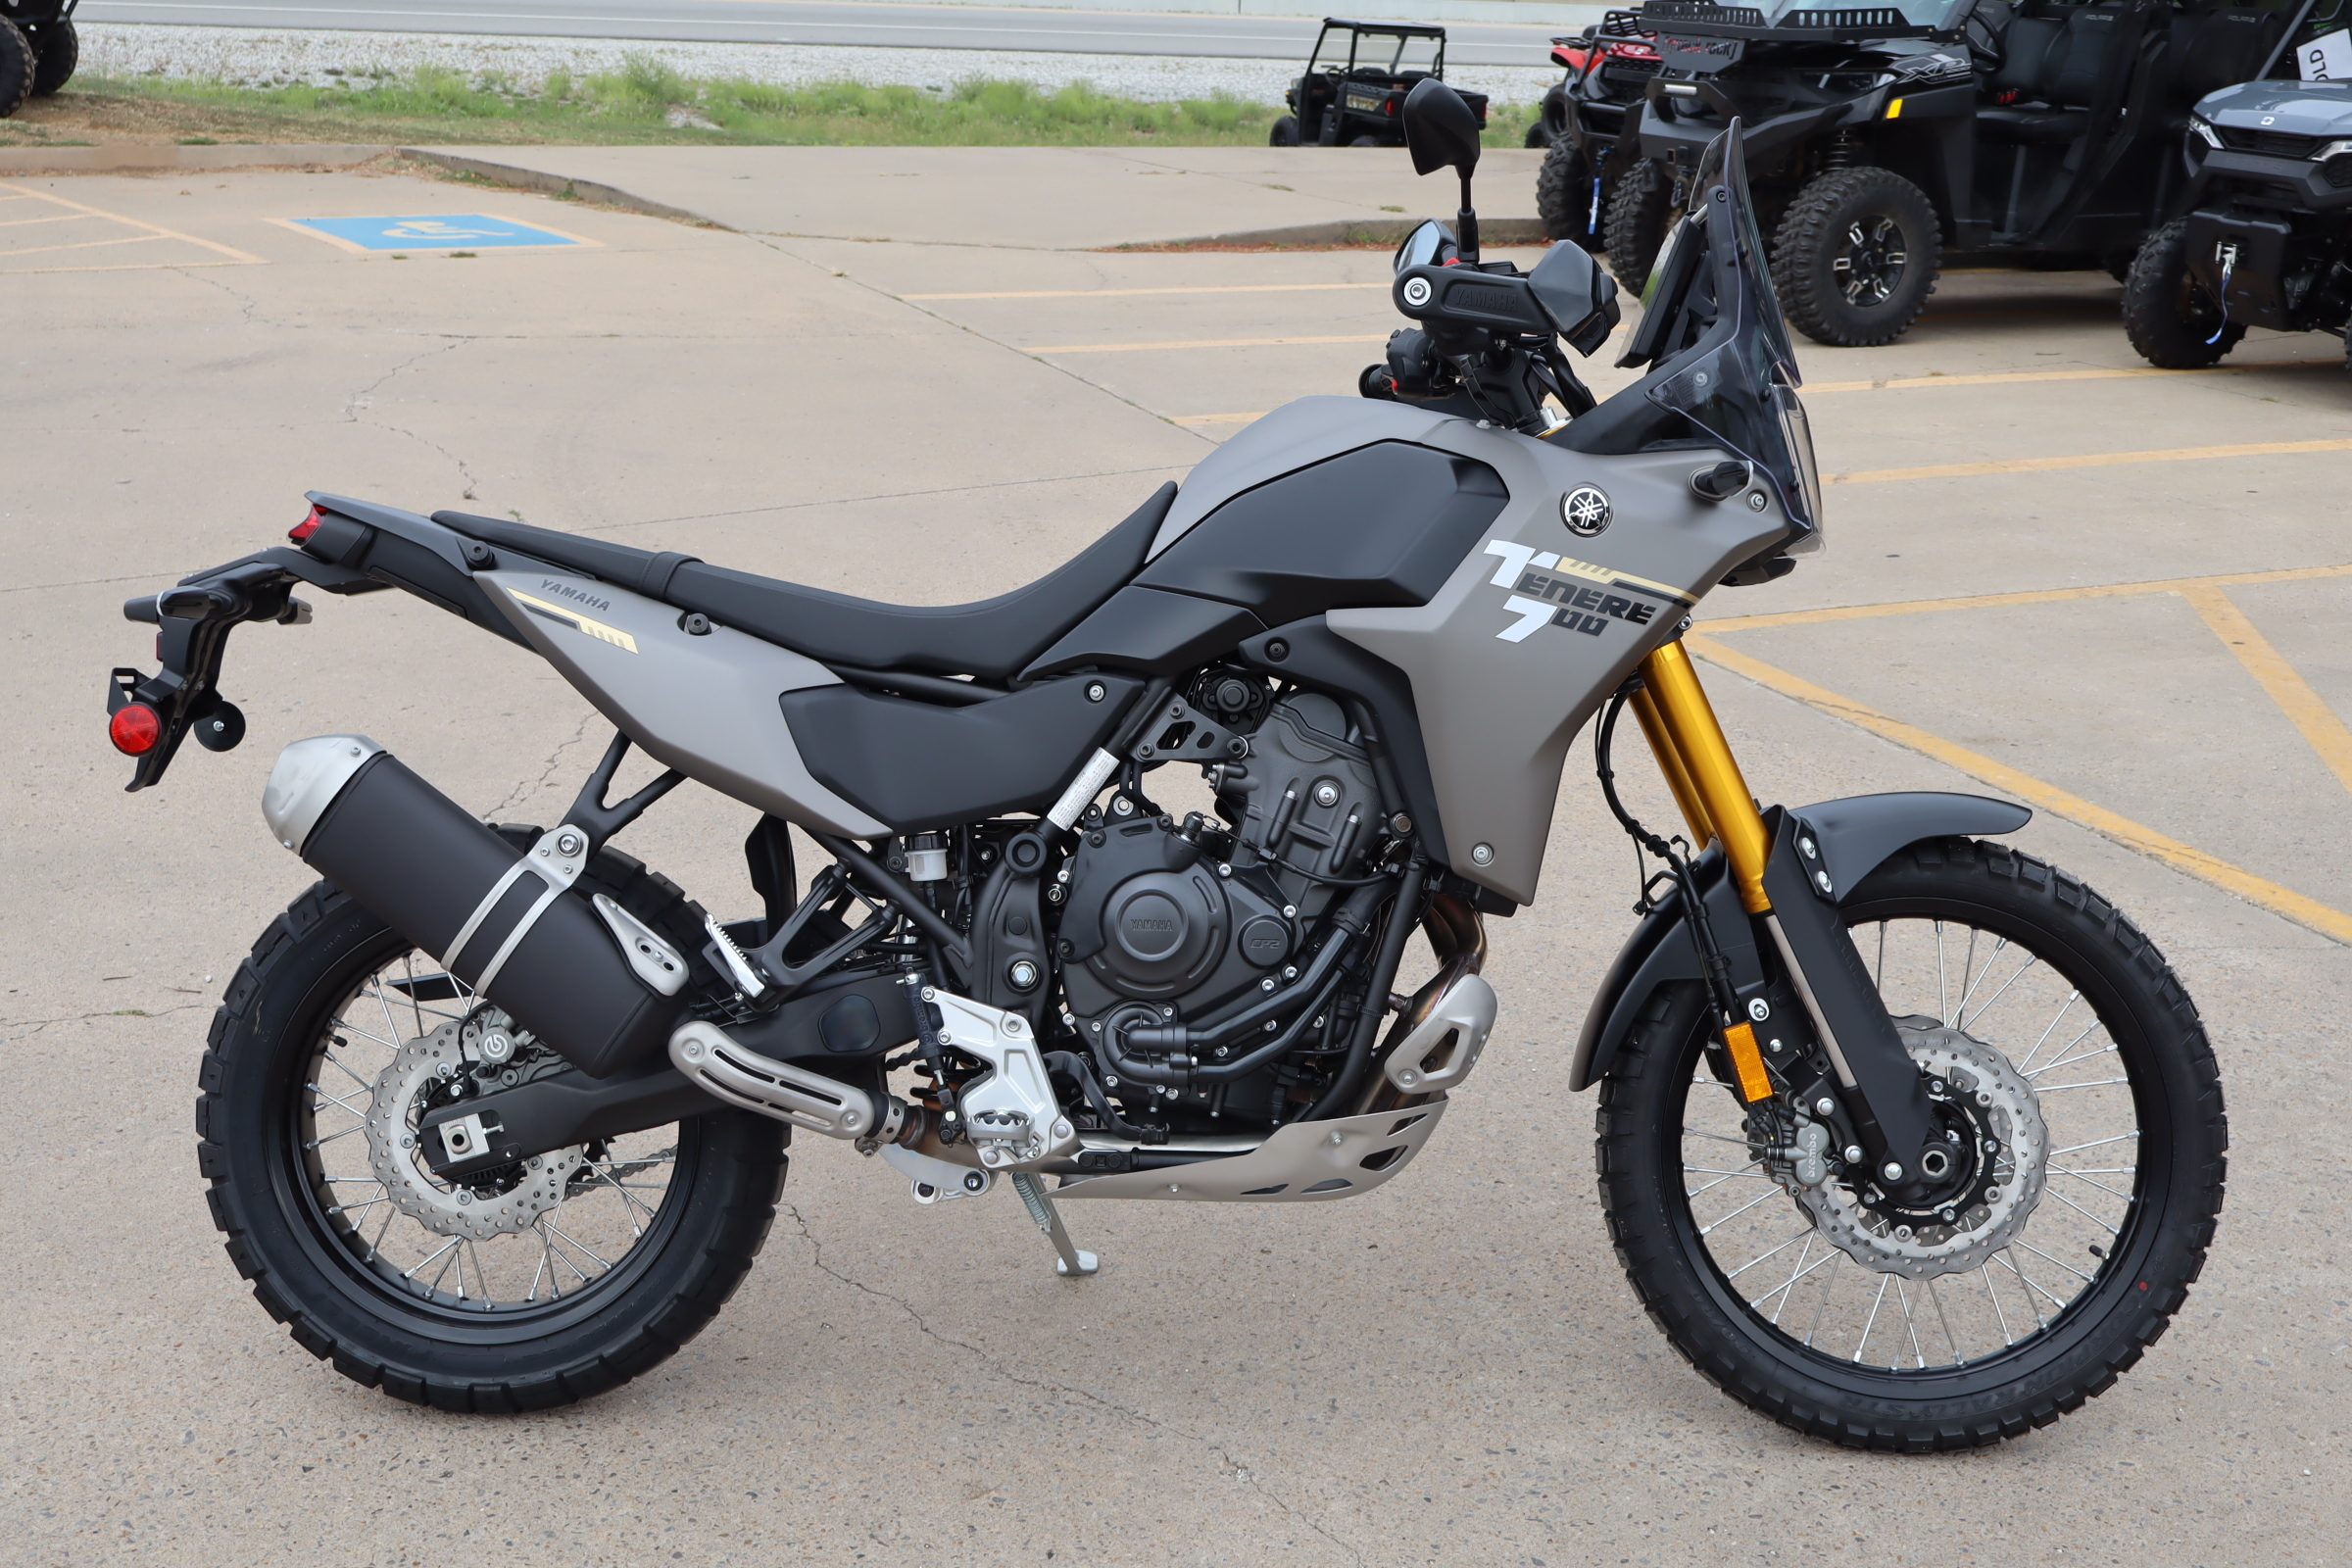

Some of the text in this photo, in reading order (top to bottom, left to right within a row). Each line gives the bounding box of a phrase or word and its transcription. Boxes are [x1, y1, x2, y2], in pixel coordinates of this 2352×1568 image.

[1453, 286, 1518, 313] YAMAHA
[541, 578, 611, 612] YAMAHA
[1495, 595, 1609, 644] 700
[1130, 918, 1174, 932] YAMAHA
[1250, 938, 1280, 950] CP2
[1805, 1133, 1817, 1178] brembo
